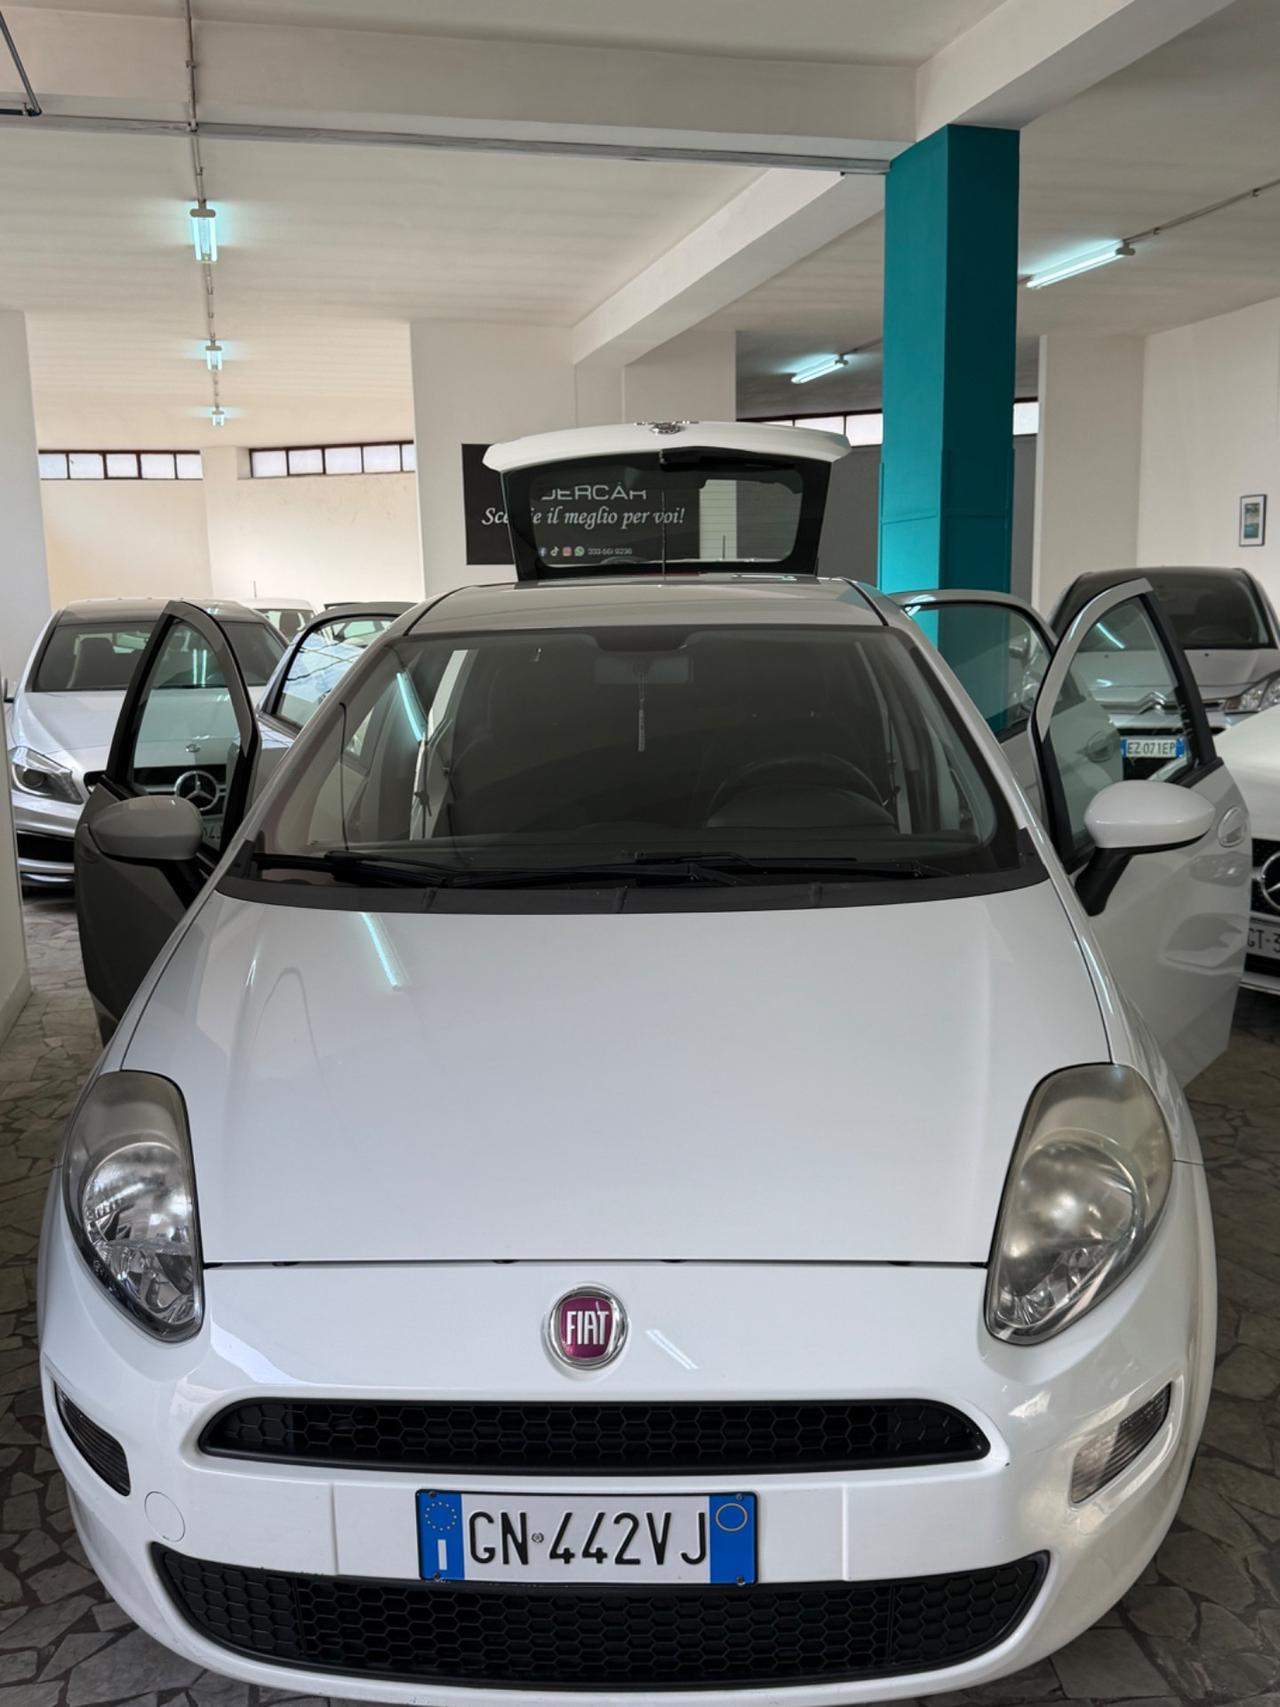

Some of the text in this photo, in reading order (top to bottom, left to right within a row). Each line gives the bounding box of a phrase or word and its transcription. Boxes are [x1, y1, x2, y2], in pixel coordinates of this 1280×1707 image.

[547, 506, 563, 525] il
[564, 506, 618, 530] meglio
[621, 510, 650, 530] per
[652, 507, 685, 525] voi!
[566, 1310, 609, 1345] FIAT
[468, 1511, 530, 1565] GN
[548, 1512, 707, 1566] 442VJ
